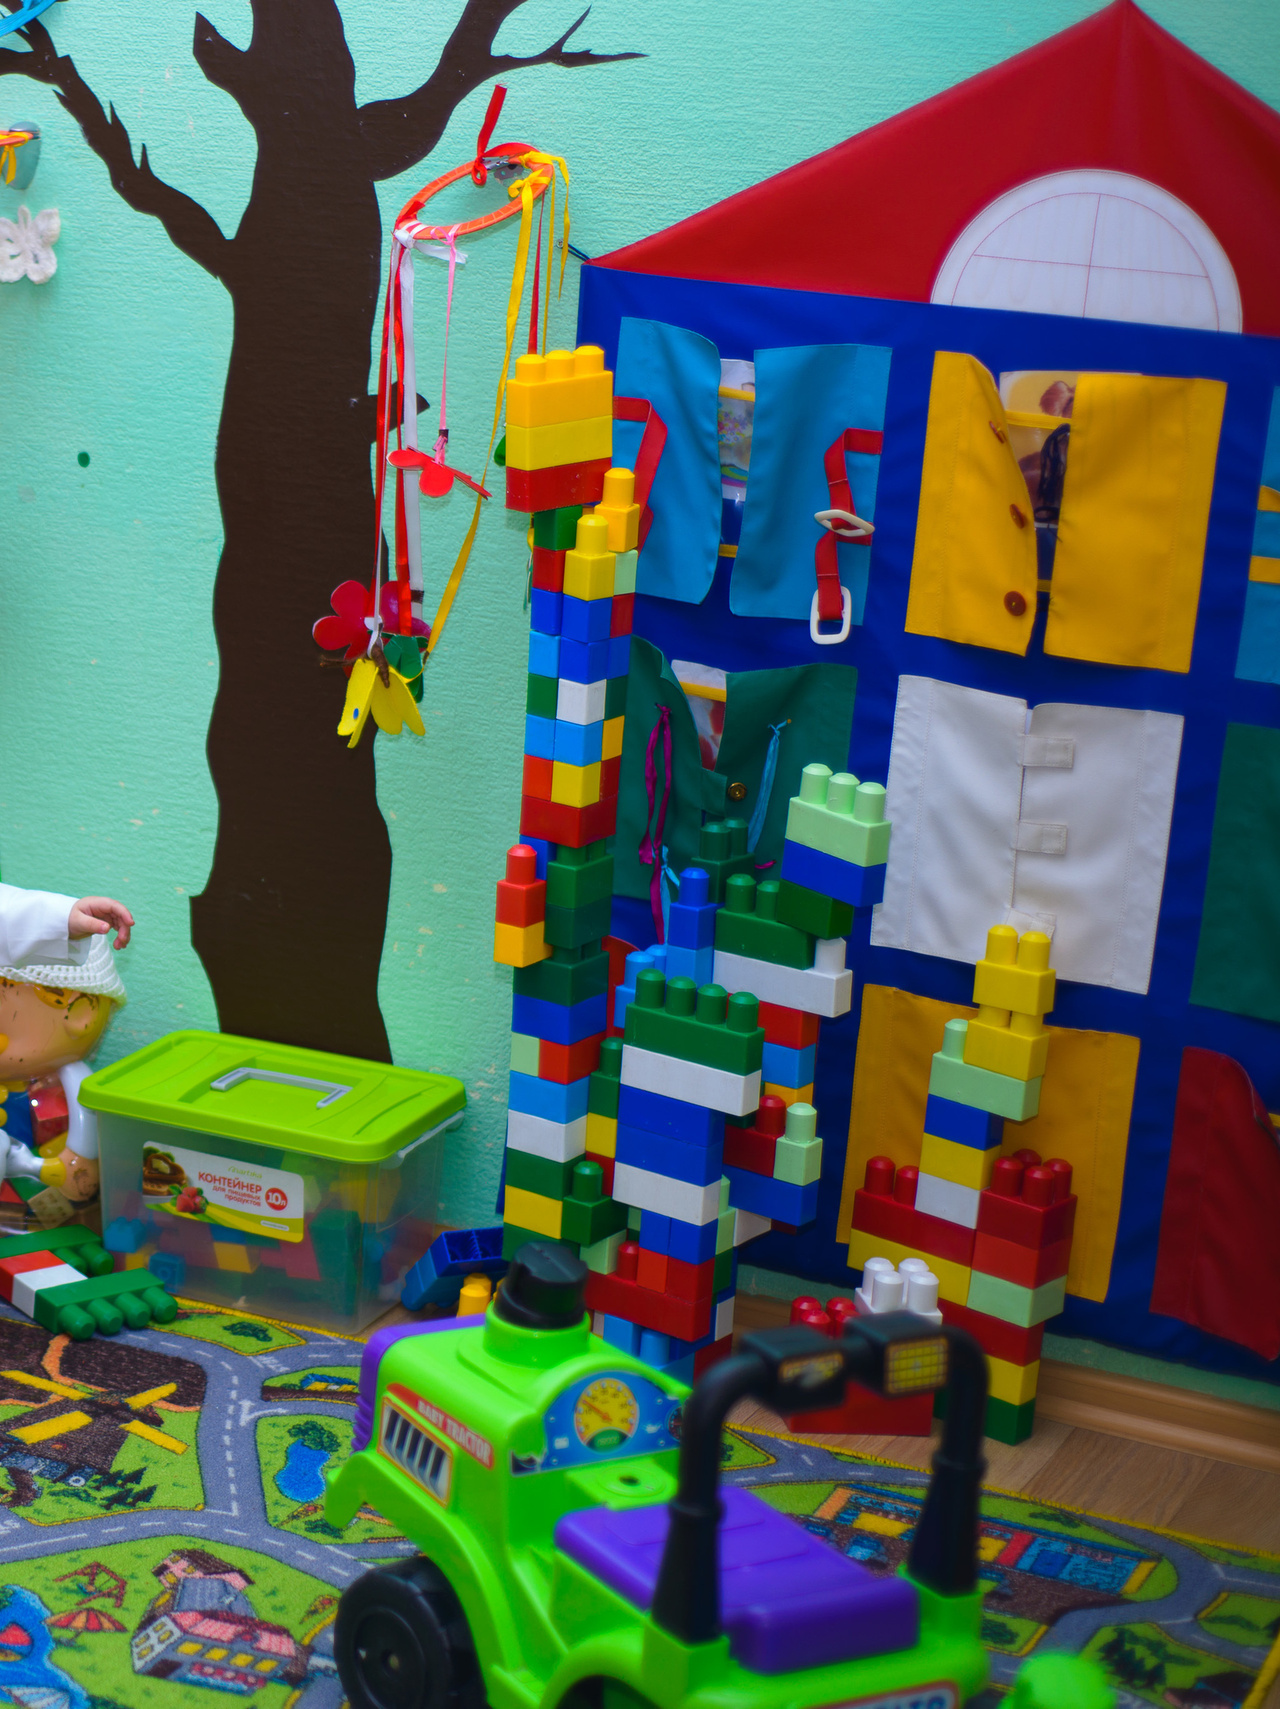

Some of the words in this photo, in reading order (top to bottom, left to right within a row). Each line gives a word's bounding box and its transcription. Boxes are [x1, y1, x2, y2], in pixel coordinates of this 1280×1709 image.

[198, 1171, 262, 1194] КОНТЕЙНЕР
[418, 1400, 445, 1429] BABY
[446, 1418, 491, 1467] TRACTOR
